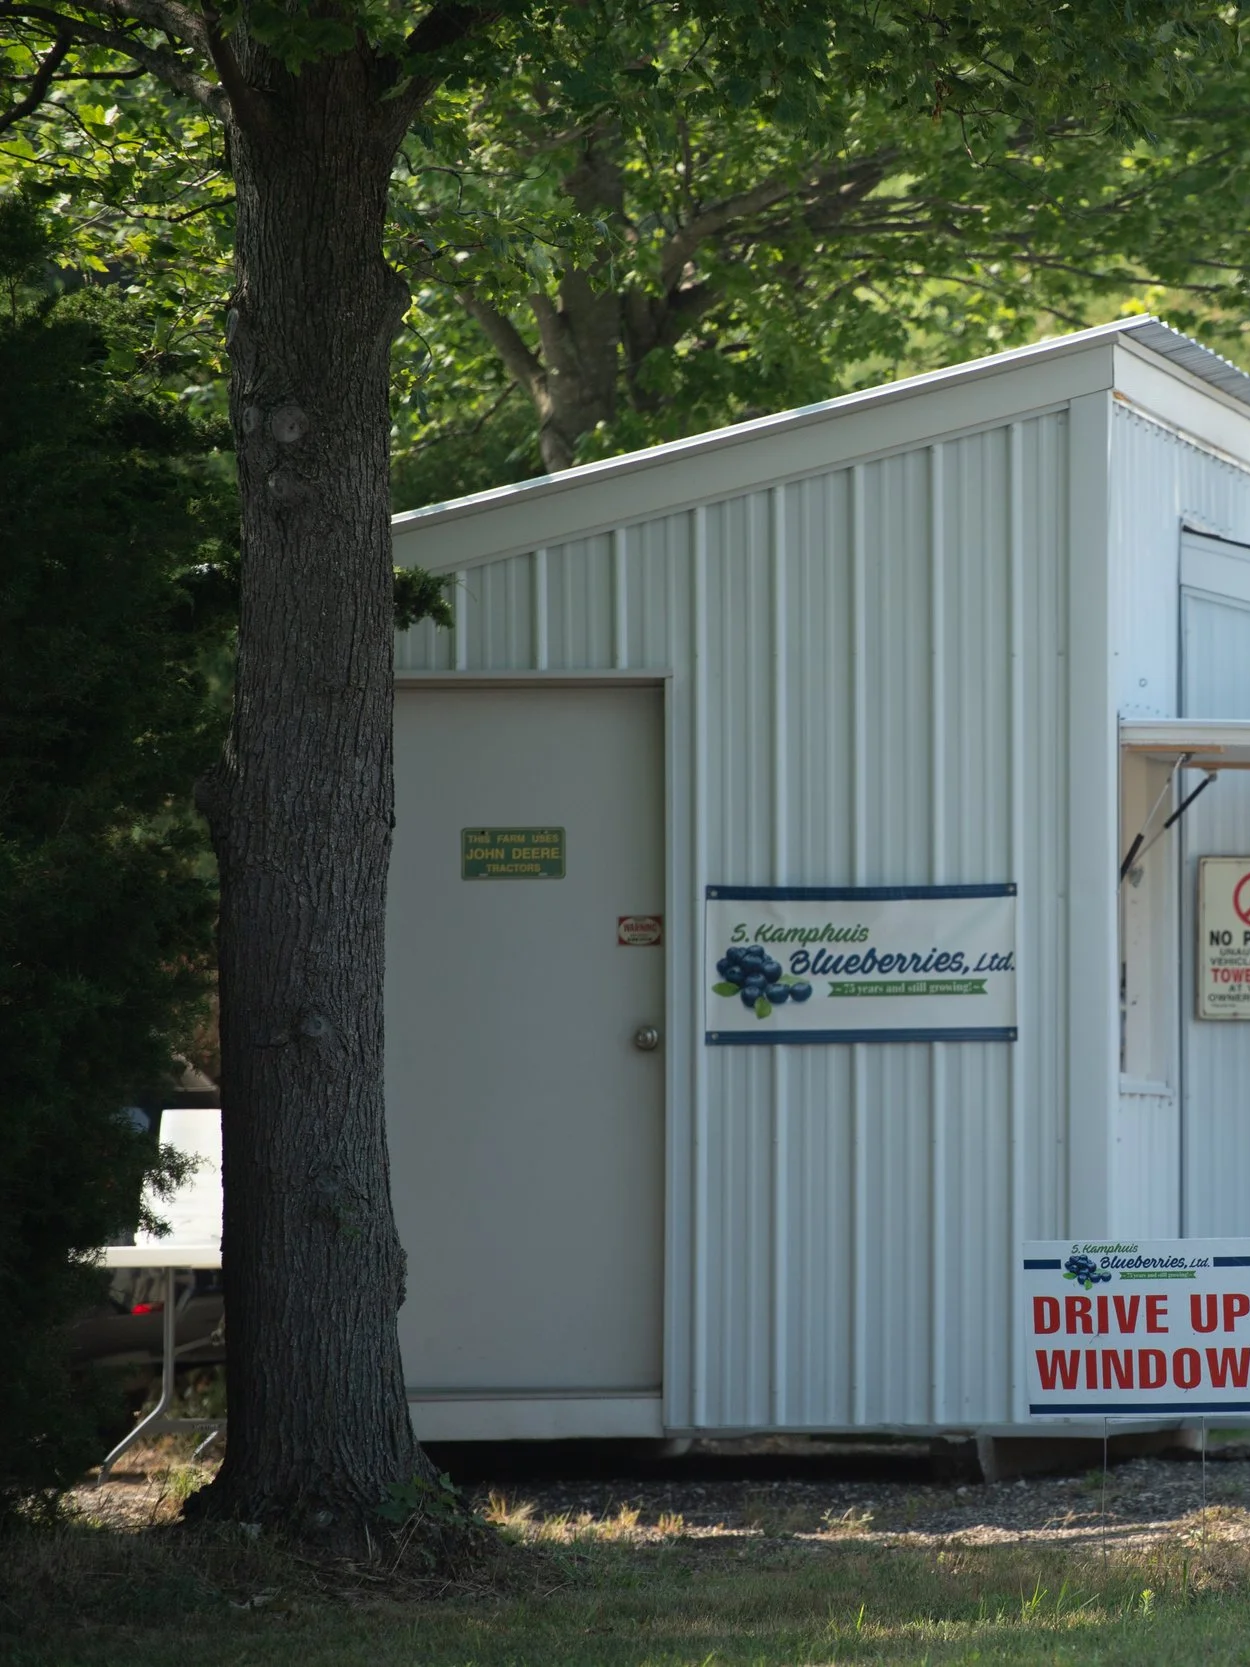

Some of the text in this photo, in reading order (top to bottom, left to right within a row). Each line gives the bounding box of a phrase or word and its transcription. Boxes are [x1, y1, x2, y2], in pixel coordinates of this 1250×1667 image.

[467, 833, 560, 844] THIS FARM USES
[466, 847, 561, 860] JOHN DEERE
[486, 863, 541, 873] TRACTORS
[730, 922, 870, 948] S. Kamphuis
[1209, 930, 1233, 946] NO
[788, 947, 1016, 976] Blueberries, Ltd.
[856, 984, 883, 996] years
[885, 982, 905, 993] and
[907, 982, 927, 993] still
[1229, 984, 1242, 992] AT
[1071, 1243, 1139, 1256] S. Kamphuis
[1100, 1255, 1211, 1269] Blueberries, Ltd.
[1032, 1293, 1250, 1335] DRIVE UP
